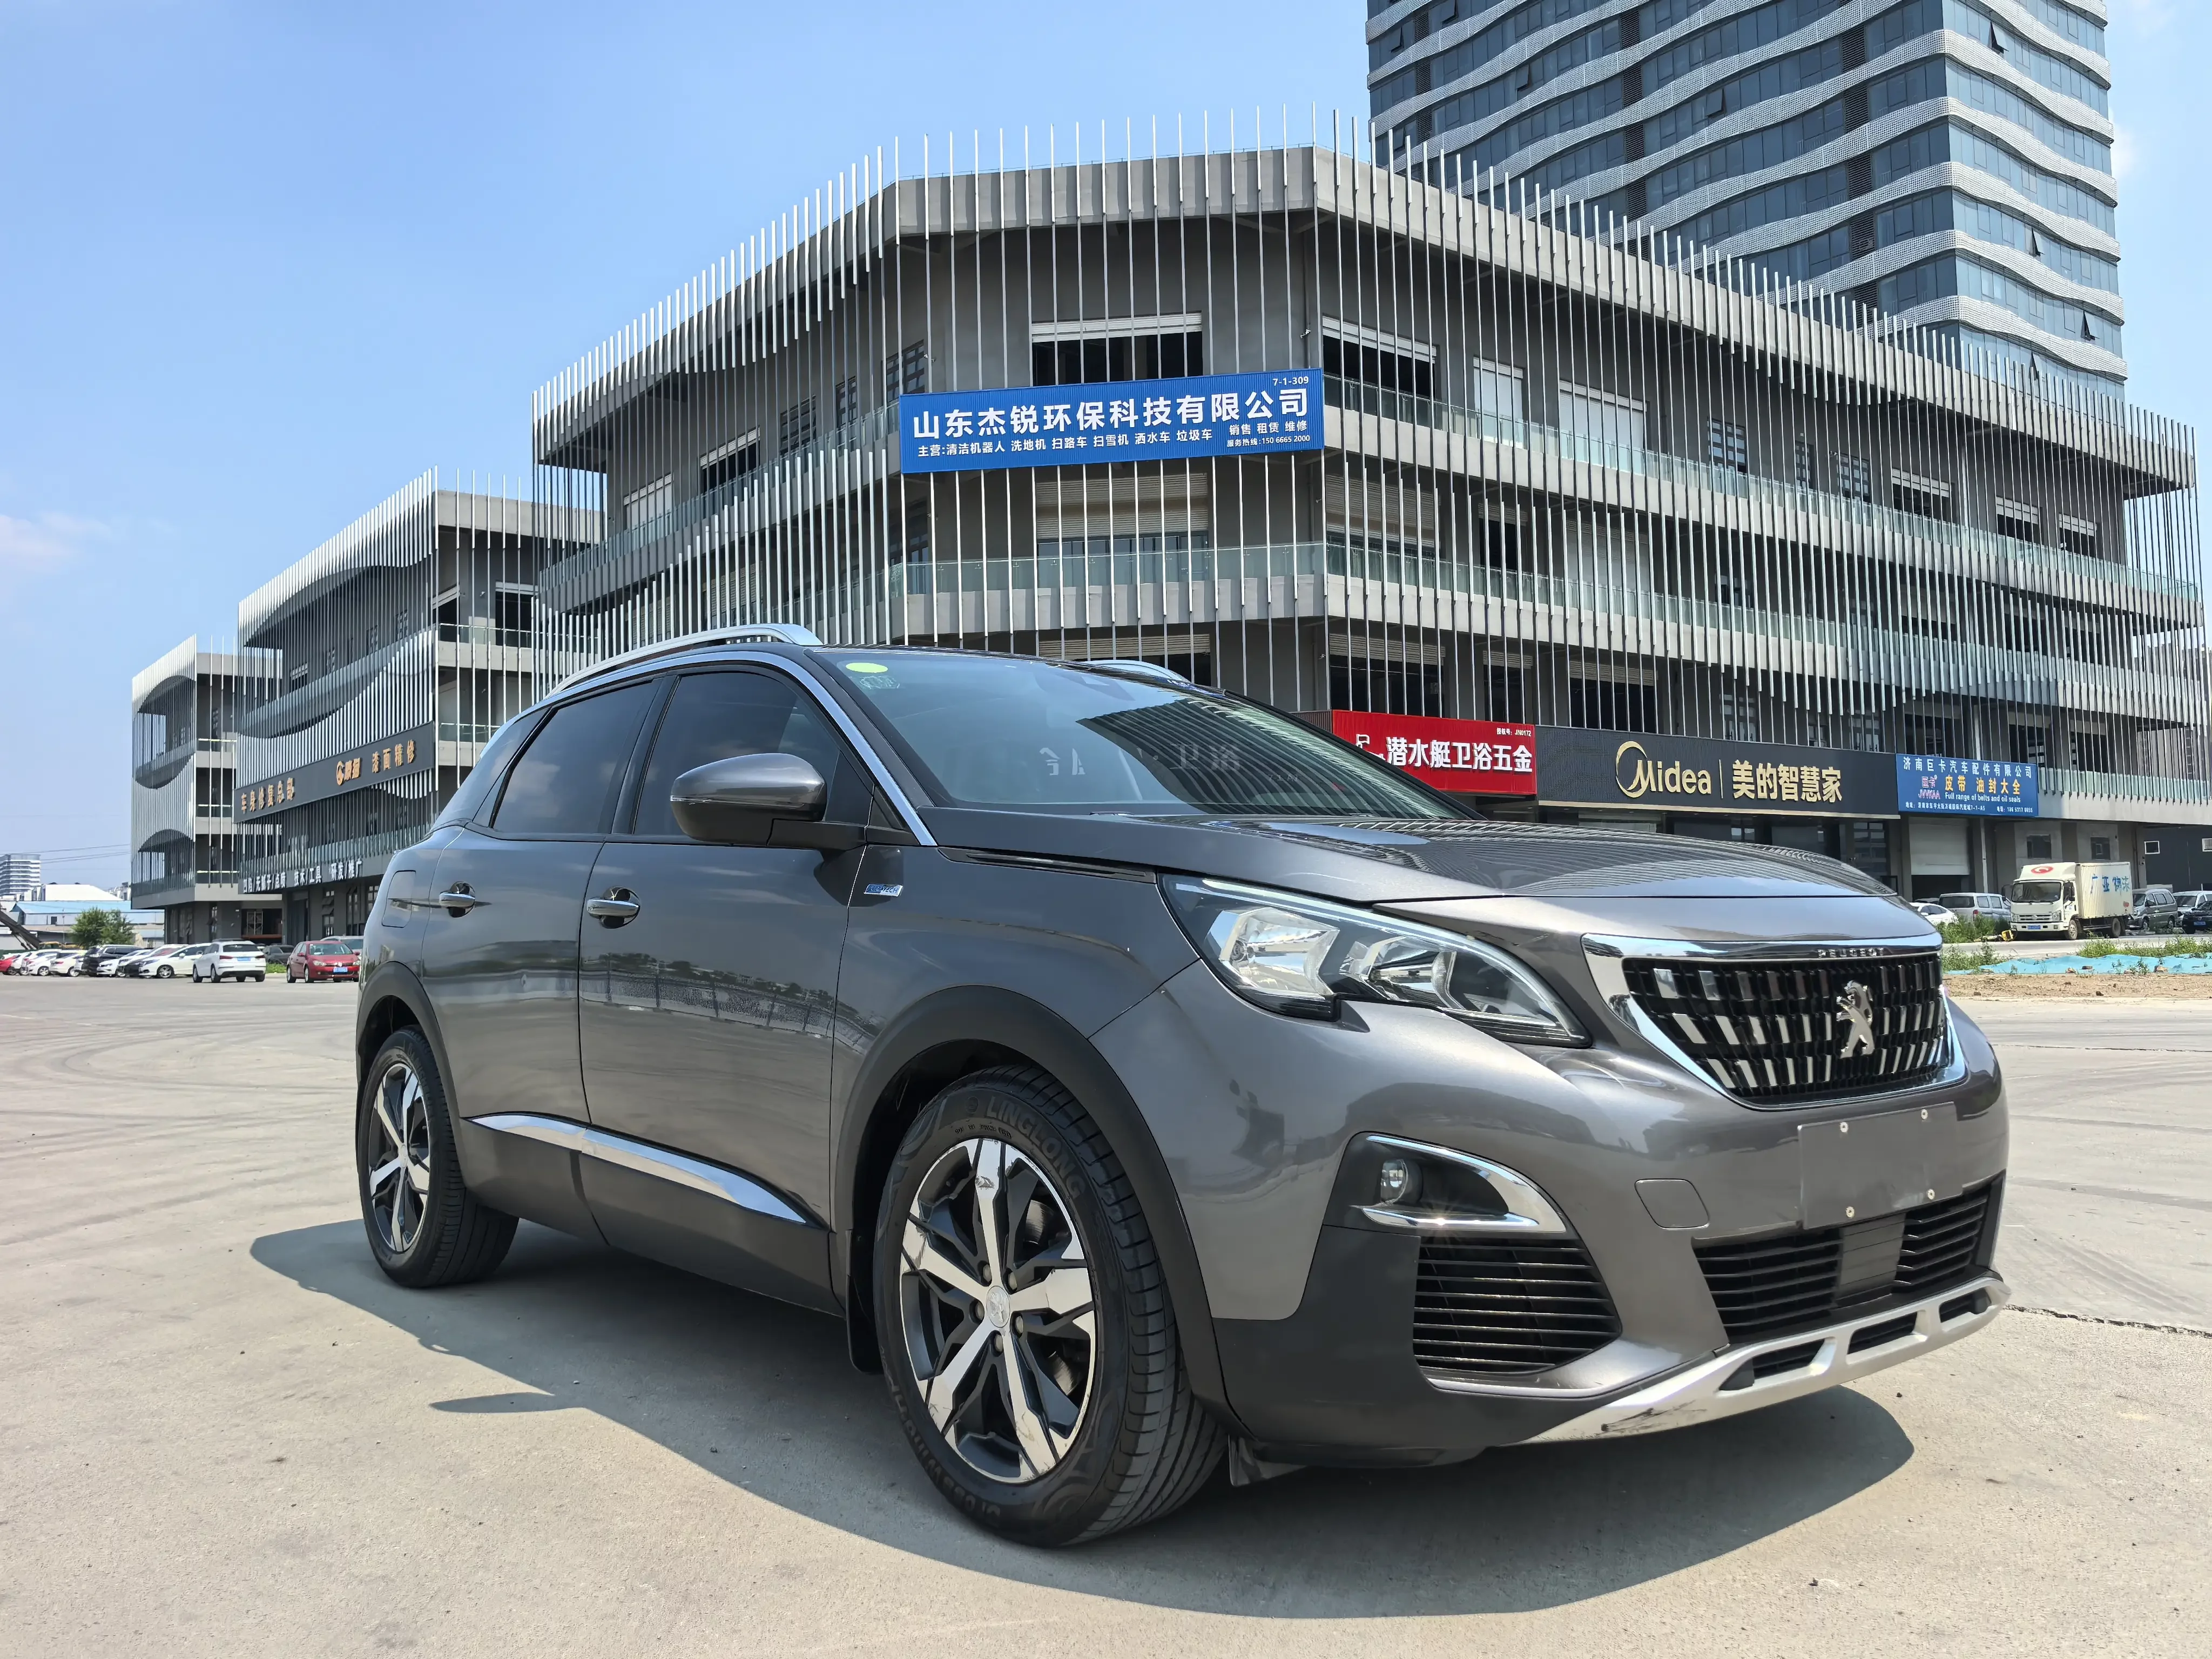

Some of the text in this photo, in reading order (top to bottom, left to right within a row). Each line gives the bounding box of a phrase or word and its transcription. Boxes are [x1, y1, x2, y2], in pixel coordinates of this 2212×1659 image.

[1272, 376, 1309, 386] 7-1-309
[913, 388, 1307, 439] 山东杰锐环保科技有限公司
[1229, 420, 1307, 435] 销售 租赁 维修
[1293, 435, 1311, 443] 2000
[1010, 439, 1047, 451] 洗地机
[1051, 436, 1088, 449] 扫路车
[1093, 434, 1129, 447] 扫雪机
[1135, 431, 1171, 445] 洒水车
[1176, 428, 1213, 442] 垃圾车
[1385, 736, 1533, 773] 潜水艇卫浴五金
[1616, 741, 1712, 798] Midea
[1903, 756, 2032, 779] 济南巨卡汽车配件有限公司
[1732, 759, 1843, 803] 美的智慧家
[1945, 774, 2021, 795] 皮带 油封大全
[1955, 794, 1970, 802] range
[986, 1095, 1087, 1199] LINGLONG
